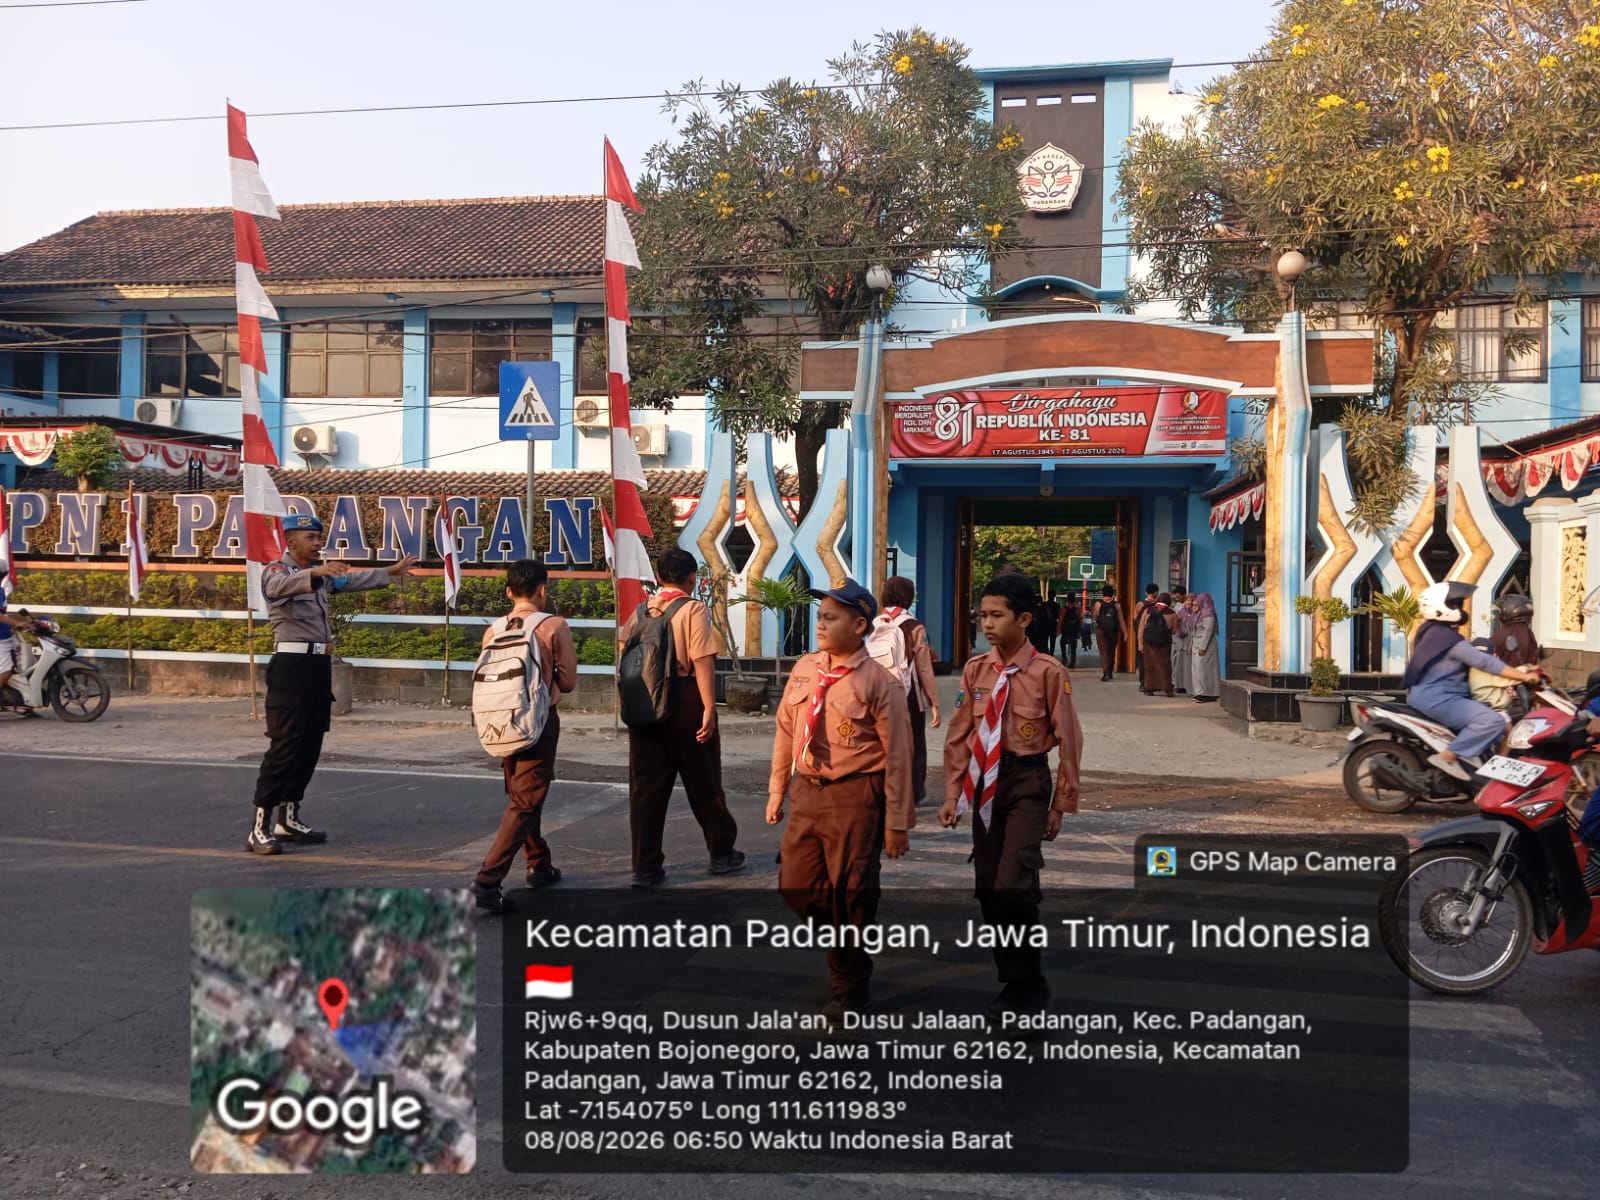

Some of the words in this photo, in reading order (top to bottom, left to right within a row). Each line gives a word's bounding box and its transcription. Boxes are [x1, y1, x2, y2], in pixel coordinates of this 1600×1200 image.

[1002, 391, 1117, 415] Dirgahayu
[976, 414, 1054, 428] REPUBLIK
[1058, 412, 1147, 427] INDONESIA
[1069, 428, 1091, 441] 81
[1002, 448, 1036, 456] AGUSTUS
[172, 494, 594, 565] PAANGAN
